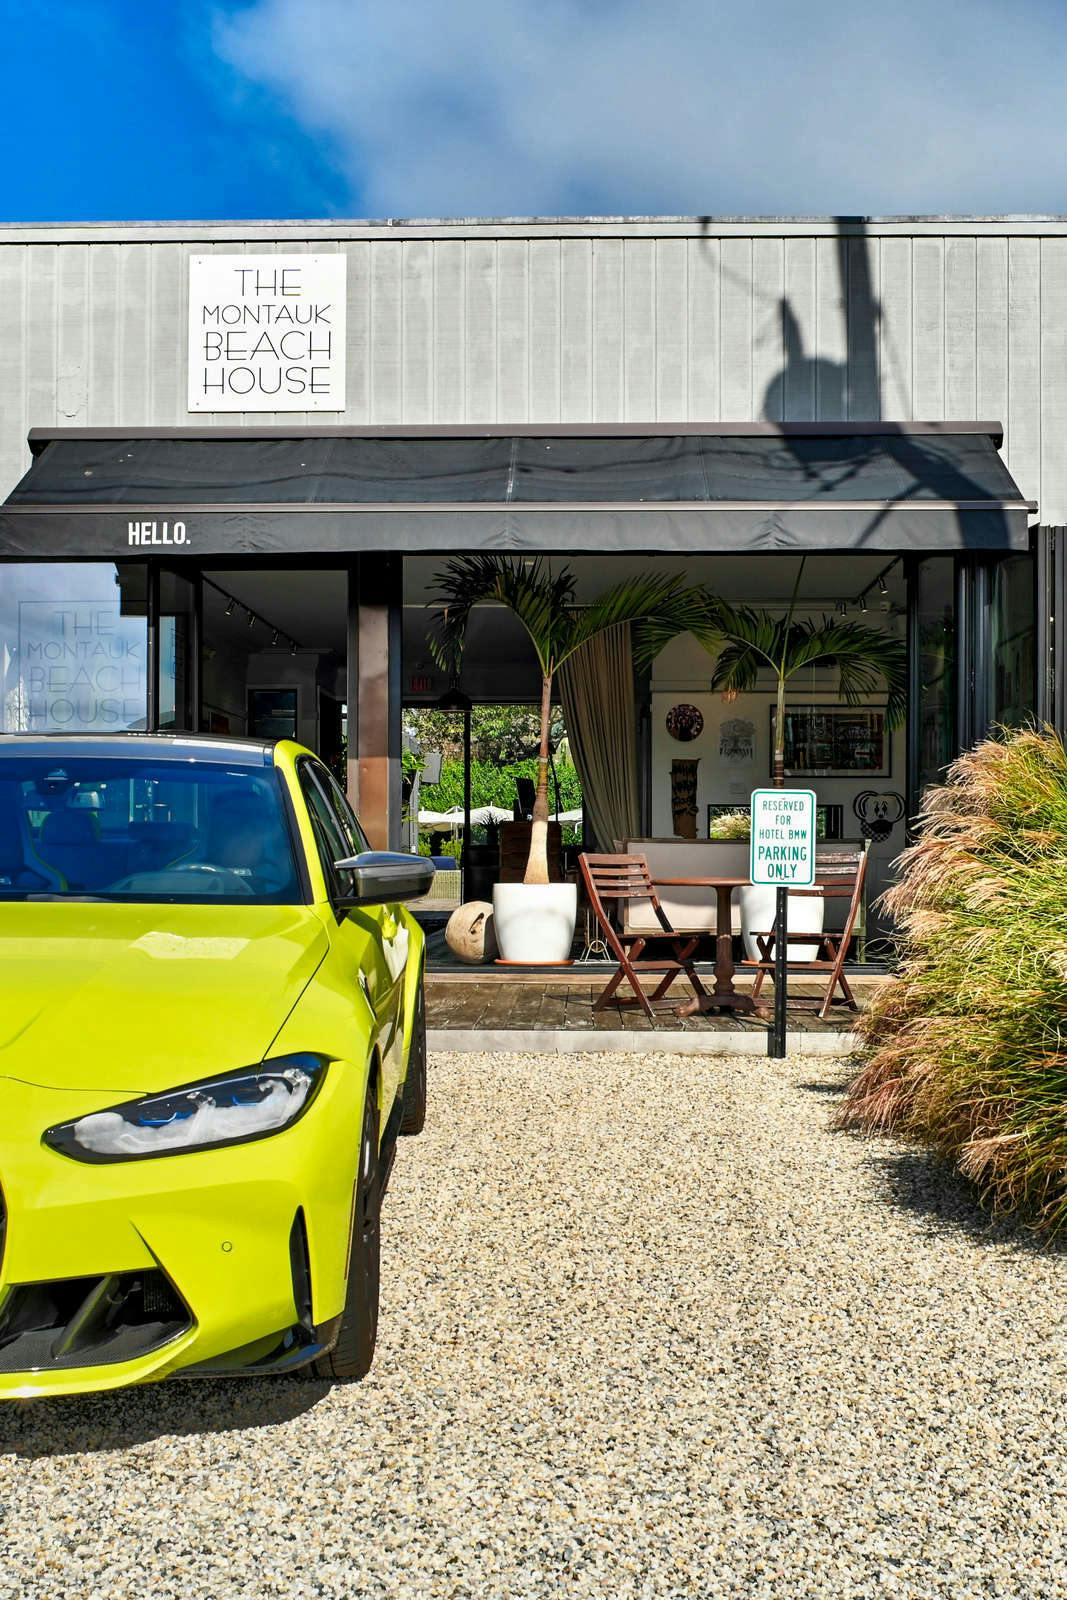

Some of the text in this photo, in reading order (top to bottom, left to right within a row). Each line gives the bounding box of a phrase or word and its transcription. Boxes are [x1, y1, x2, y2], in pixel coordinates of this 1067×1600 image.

[234, 268, 302, 297] THE
[203, 304, 331, 325] MONTAUK
[203, 330, 331, 361] BEACH
[203, 366, 331, 395] HOUSE
[128, 521, 191, 546] HELLO.
[53, 610, 114, 636] THE
[27, 641, 141, 660] MONTAUK
[28, 666, 141, 693] BEACH
[28, 699, 141, 724] HOUSE
[762, 800, 805, 812] RESERVED
[775, 814, 792, 826] FOR
[759, 829, 807, 840] HOTEL BMW
[758, 846, 807, 861] PARKING
[767, 863, 798, 878] ONLY
